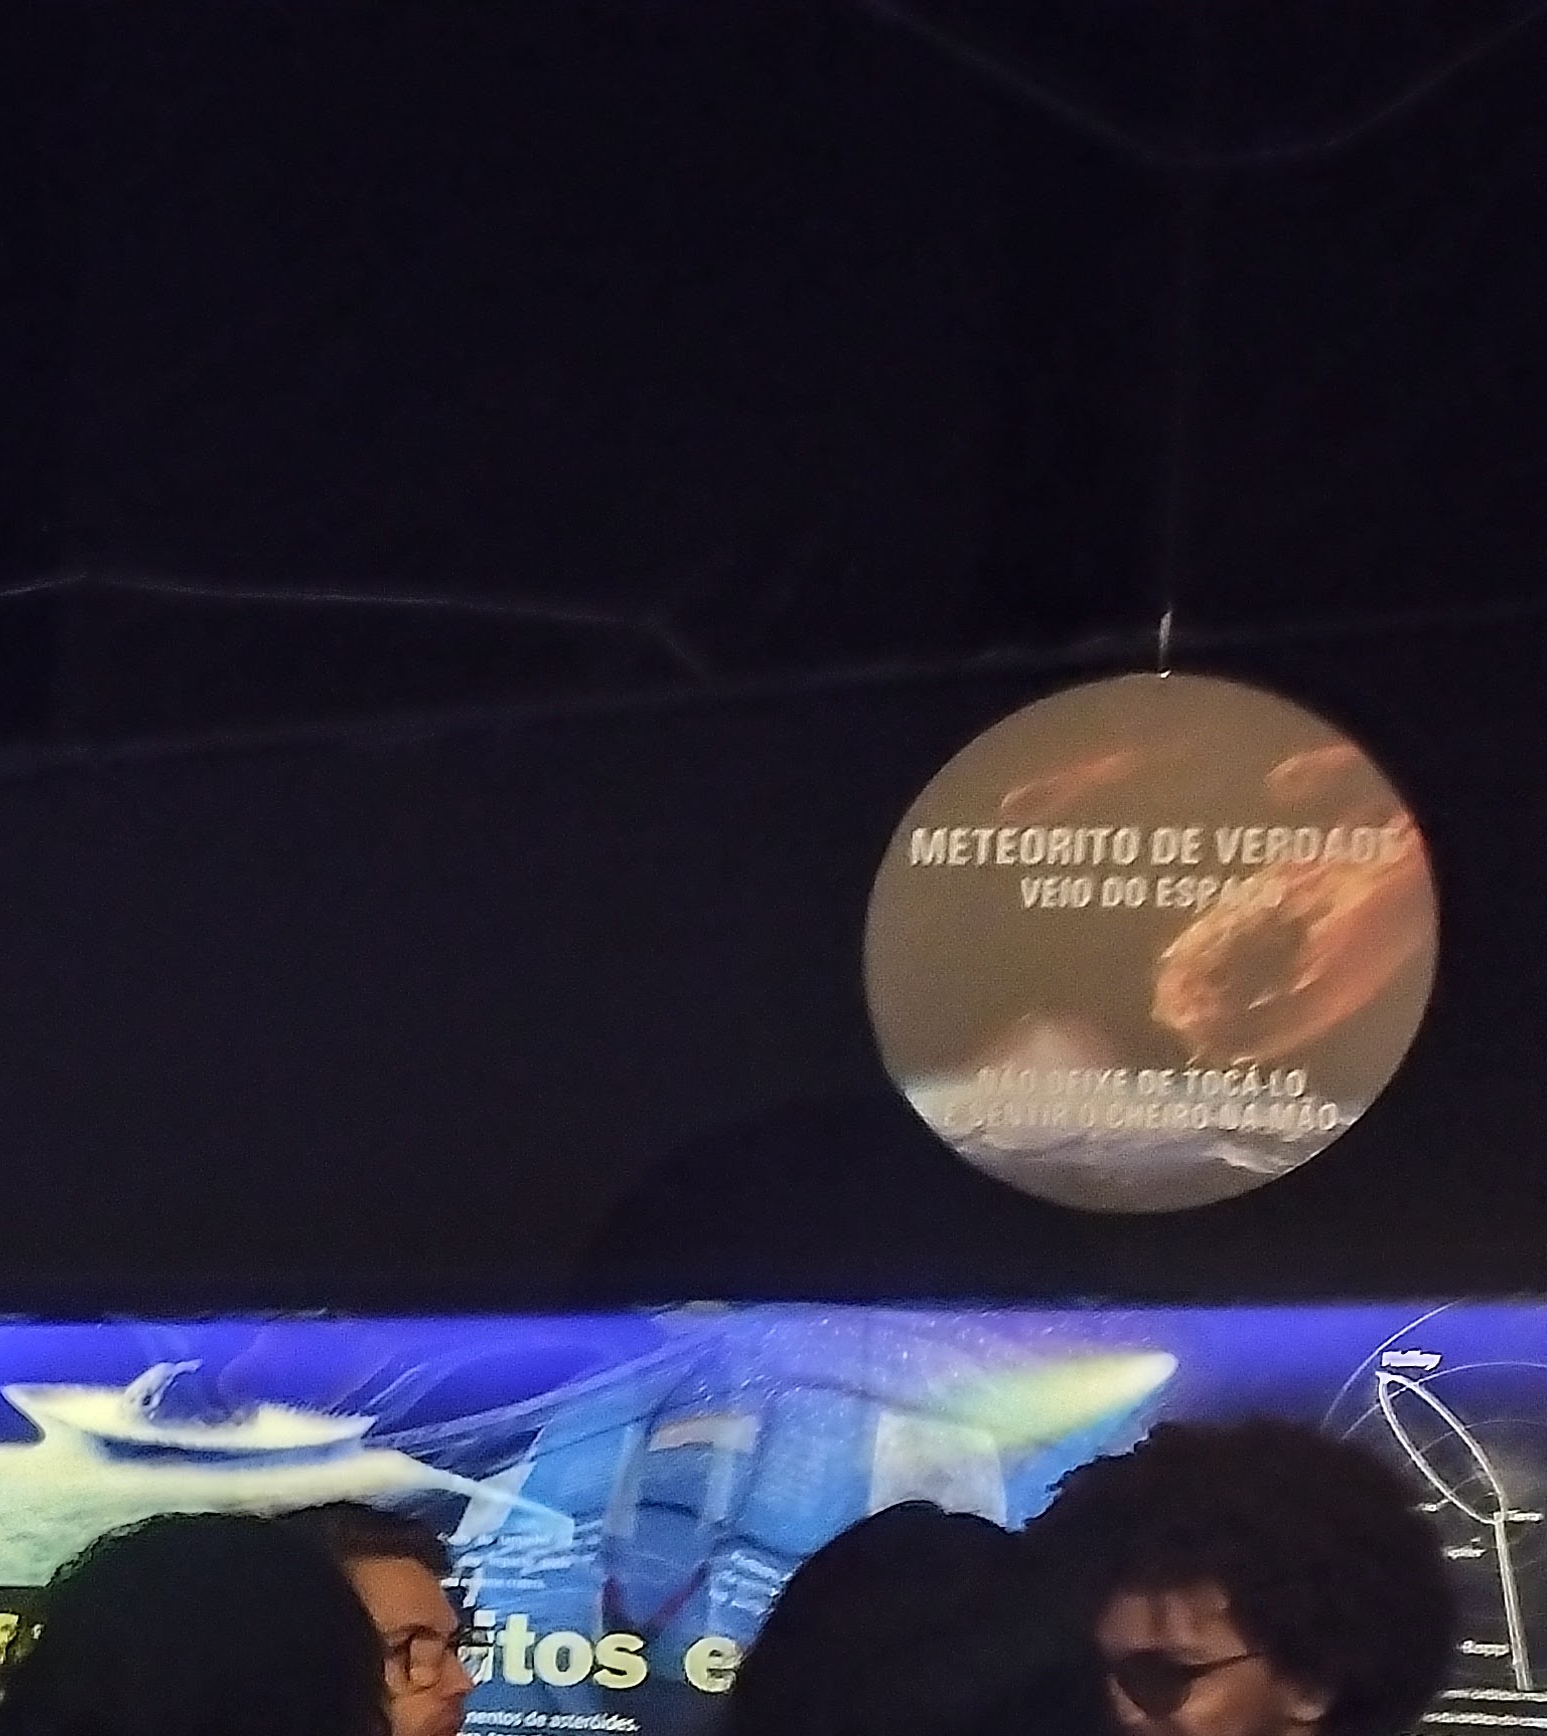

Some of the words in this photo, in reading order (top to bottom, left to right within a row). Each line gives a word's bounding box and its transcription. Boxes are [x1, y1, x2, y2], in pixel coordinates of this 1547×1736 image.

[910, 826, 1141, 867] METEORITO
[1151, 826, 1204, 866] DE
[1215, 826, 1403, 866] VERDADE
[1021, 876, 1092, 910] VEIO
[1101, 876, 1148, 909] DO
[1138, 1068, 1176, 1097] DE
[1182, 1063, 1305, 1100] TOCÁ-LO
[465, 1711, 522, 1727] mentos
